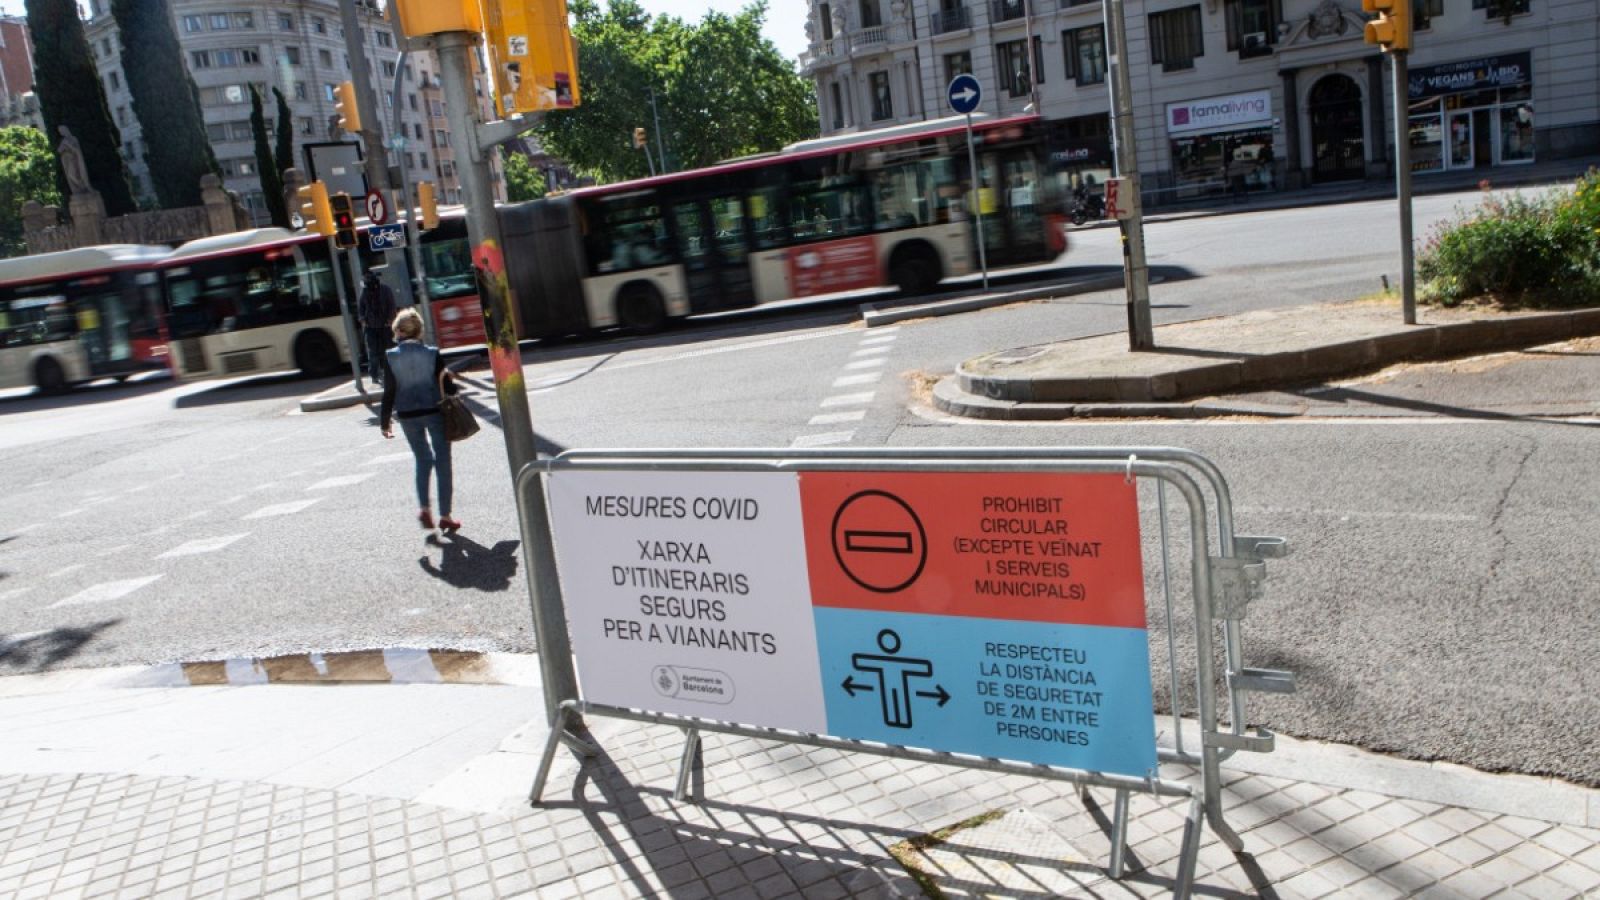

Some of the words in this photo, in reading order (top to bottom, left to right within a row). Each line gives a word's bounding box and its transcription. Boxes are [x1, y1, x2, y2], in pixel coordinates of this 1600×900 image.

[1427, 71, 1475, 88] VEGANS
[1191, 98, 1265, 118] famaliving
[585, 495, 686, 518] MESURES
[692, 497, 759, 521] COVID
[982, 496, 1063, 513] PROHIBIT
[980, 517, 1068, 535] CIRCULAR
[637, 539, 711, 564] XARXA
[953, 536, 1035, 556] (EXCEPTE
[1039, 538, 1102, 558] VEÏNAT
[611, 565, 750, 596] D'ITINERARIS
[986, 560, 991, 575] I
[996, 560, 1070, 578] SERVEIS
[975, 579, 1086, 602] MUNICIPALS)
[639, 595, 727, 622] SEGURS
[603, 618, 643, 641] PER
[648, 623, 663, 643] A
[665, 624, 777, 655] VIANANTS
[984, 642, 1087, 665] RESPECTEU
[979, 661, 1002, 677] LA
[1005, 663, 1097, 686] DISTÀNCIA
[682, 681, 724, 695] Barcelona
[976, 681, 999, 697] DE
[1003, 683, 1103, 708] SEGURETAT
[984, 701, 1006, 717] DE
[1011, 703, 1036, 721] 2M
[1041, 707, 1099, 728] ENTRE
[996, 722, 1089, 746] PERSONES
